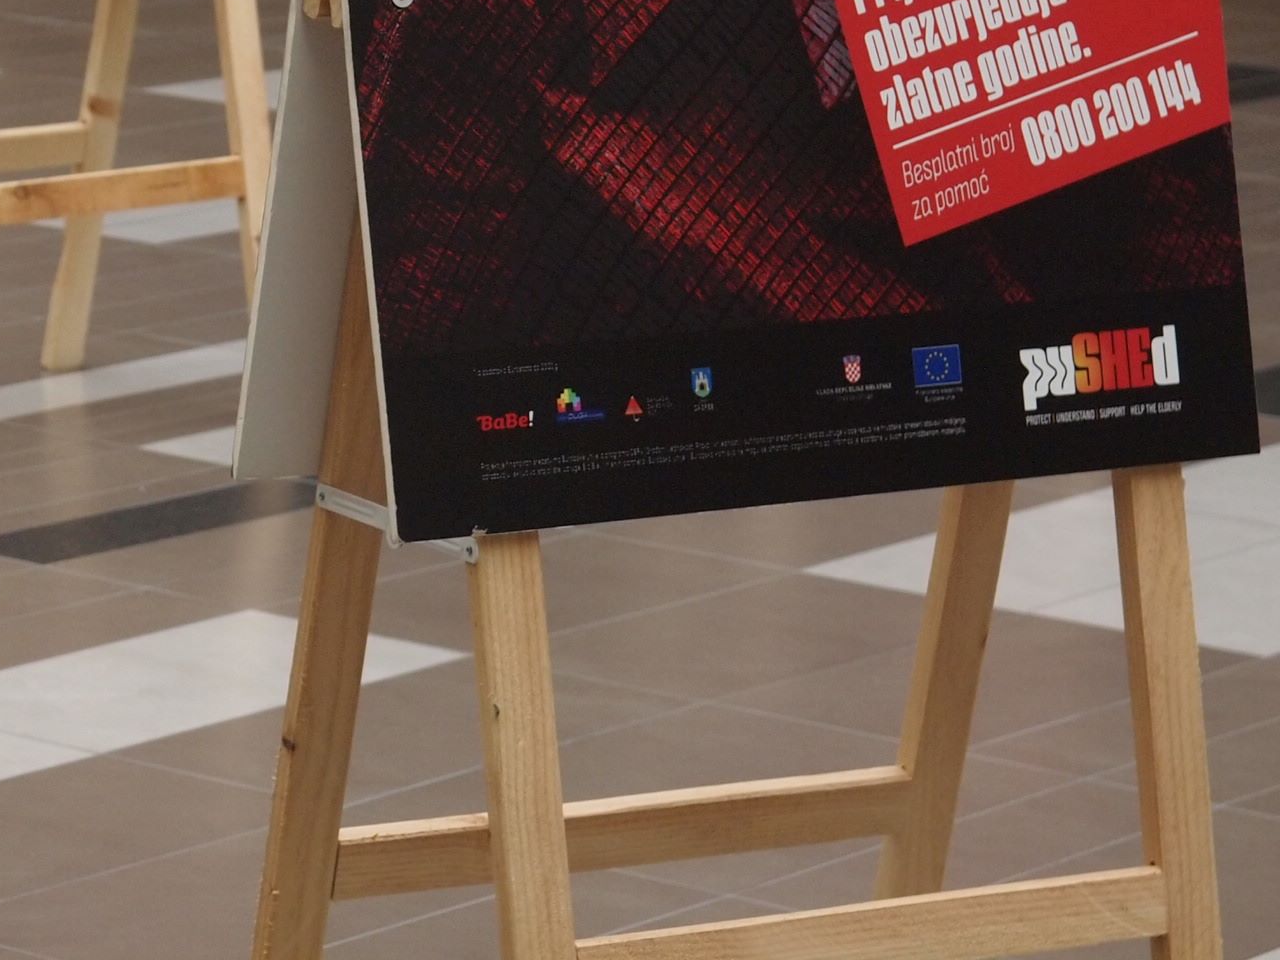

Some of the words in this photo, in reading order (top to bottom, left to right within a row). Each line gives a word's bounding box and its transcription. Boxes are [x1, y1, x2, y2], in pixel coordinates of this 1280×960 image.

[880, 62, 977, 131] zlatne
[977, 21, 1092, 101] godine.
[902, 137, 980, 188] Besplatni
[980, 123, 1016, 164] broj
[1021, 97, 1096, 167] 0800
[1094, 77, 1151, 140] 200
[1148, 59, 1202, 117] 144
[912, 197, 932, 221] za
[935, 169, 990, 215] pomoć
[477, 411, 534, 431] BaBe!
[1026, 414, 1052, 426] PROTECT
[1056, 410, 1095, 423] UNDERSTAND
[1099, 406, 1125, 419] SUPPORT
[1130, 405, 1144, 415] HELP
[1146, 404, 1156, 414] THE
[1158, 401, 1182, 412] ELDERLY
